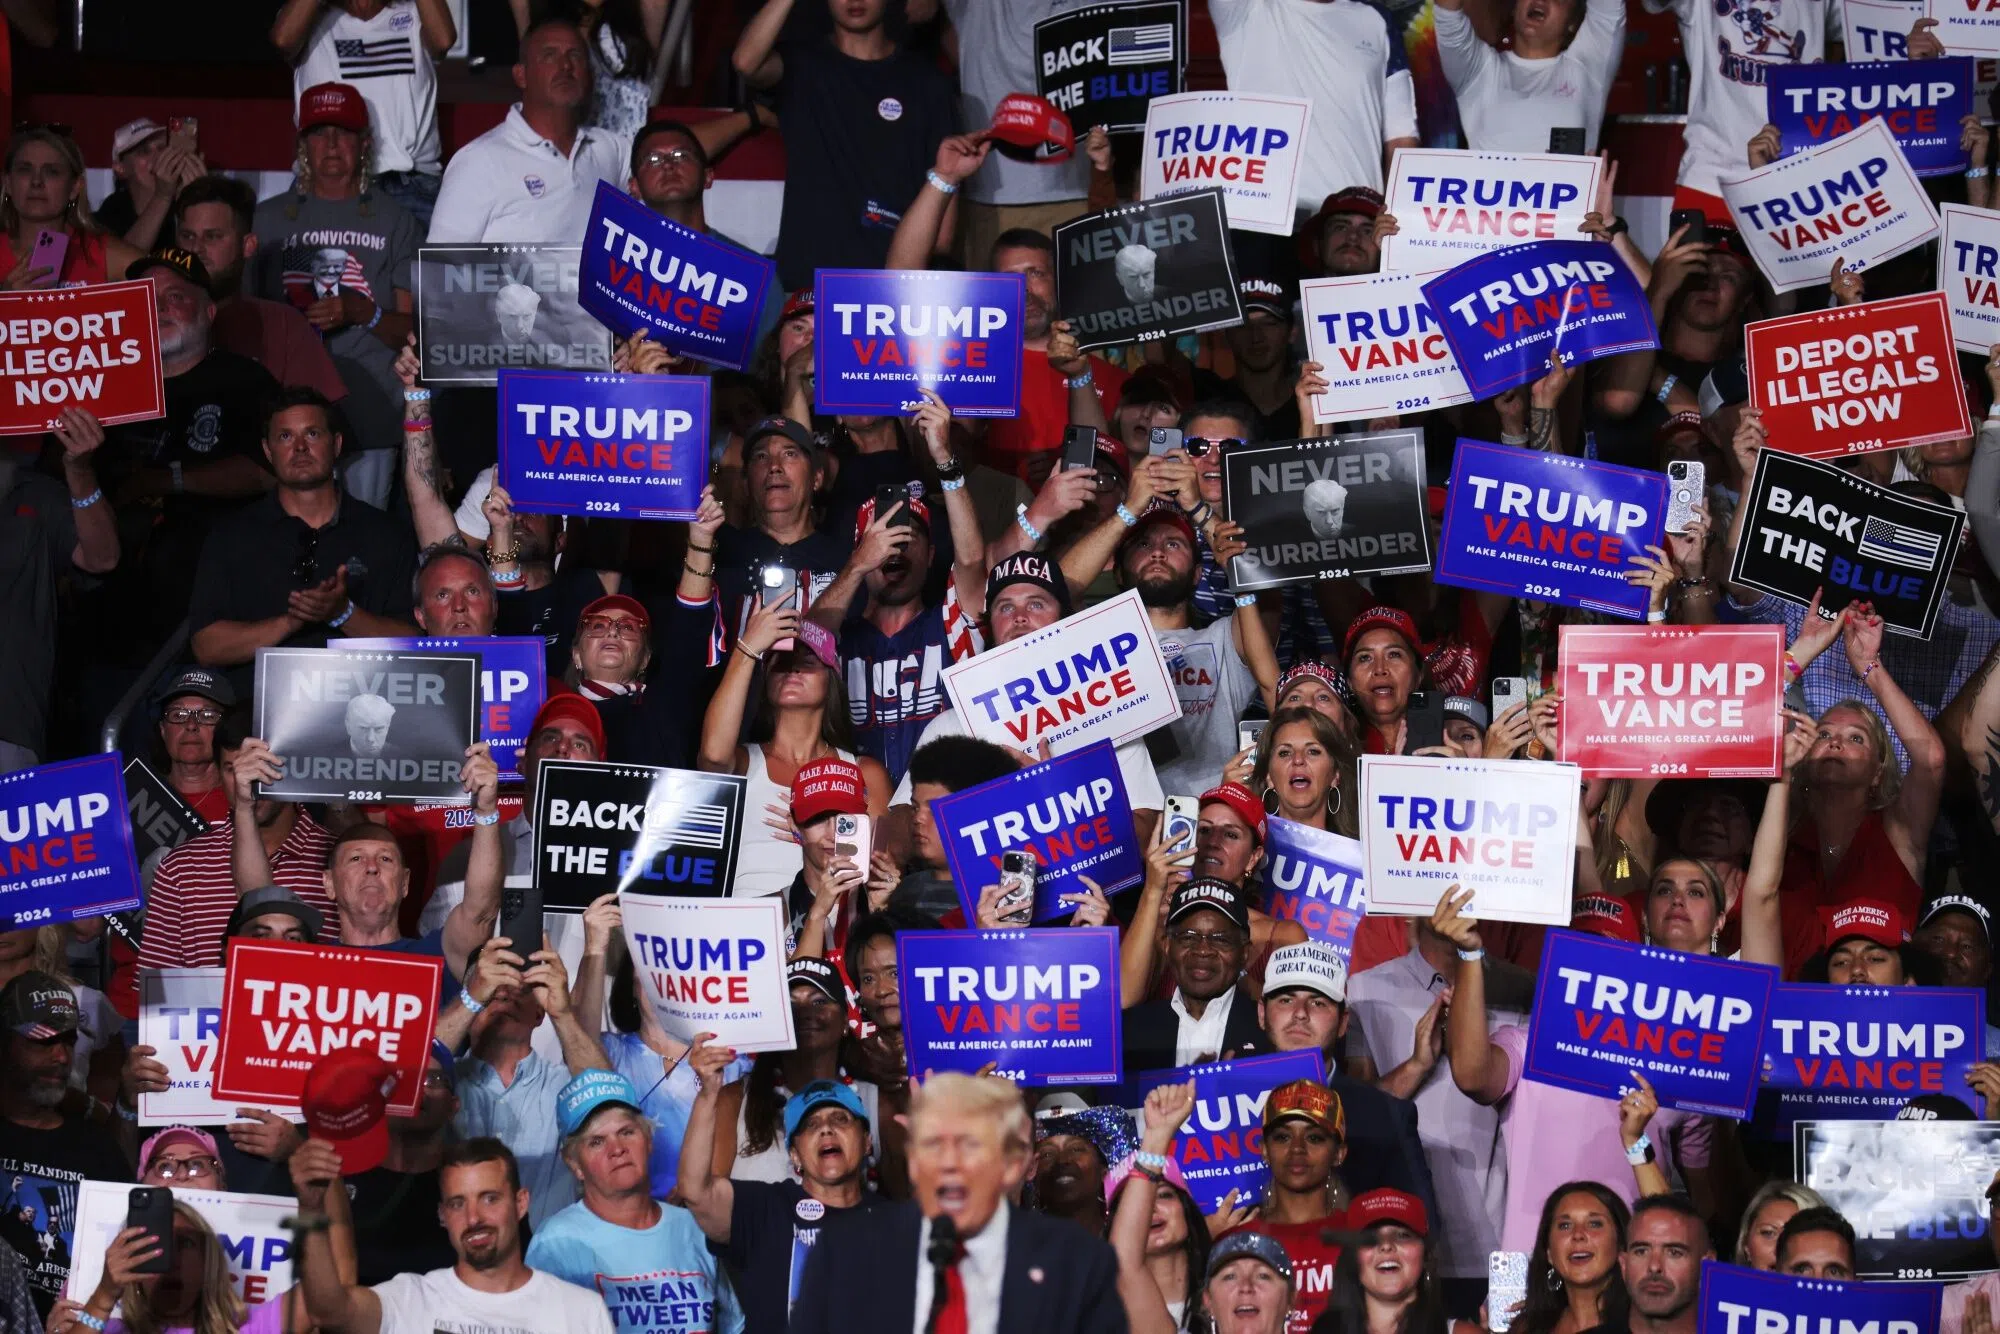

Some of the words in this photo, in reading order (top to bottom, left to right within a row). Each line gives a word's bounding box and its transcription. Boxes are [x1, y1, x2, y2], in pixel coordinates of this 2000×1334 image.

[1949, 17, 1977, 25] MAKE
[1043, 36, 1105, 77] BACK
[1046, 81, 1084, 111] THE
[1091, 71, 1169, 100] BLUE
[1784, 82, 1956, 113] TRUMP
[1154, 124, 1289, 158] TRUMP
[1910, 137, 1947, 147] AGAIN!
[1162, 155, 1266, 185] VANCE
[1236, 189, 1271, 199] AGAIN!
[1407, 176, 1578, 209] TRUMP
[1739, 156, 1889, 232] TRUMP
[1423, 207, 1557, 238] VANCE
[1769, 190, 1892, 251] VANCE
[303, 231, 386, 251] CONVICTIONS
[1070, 213, 1197, 266] NEVER
[1409, 239, 1438, 247] MAKE
[1442, 241, 1487, 250] AMERICA
[1777, 253, 1799, 265] MAKE
[1801, 245, 1839, 262] AMERICA
[1840, 232, 1872, 248] GREAT
[1874, 211, 1908, 236] AGAIN!
[602, 218, 748, 307] TRUMP
[609, 257, 723, 331] VANCE
[1450, 261, 1614, 328] TRUMP
[596, 281, 616, 299] MAKE
[617, 297, 652, 322] AMERICA
[655, 318, 686, 337] GREAT
[690, 330, 726, 344] AGAIN!
[833, 303, 1008, 339] TRUMP
[1066, 287, 1230, 337] SURRENDER
[1481, 284, 1612, 340] VANCE
[1955, 308, 1975, 319] MAKE
[1137, 330, 1166, 342] 2024
[1484, 345, 1513, 361] MAKE
[1515, 330, 1553, 348] AMERICA
[1555, 319, 1587, 336] GREAT
[1590, 312, 1626, 324] AGAIN!
[1775, 325, 1919, 373] DEPORT
[430, 344, 609, 366] SURRENDER
[852, 339, 987, 368] VANCE
[1340, 334, 1447, 372] VANC
[15, 373, 104, 406] NOW
[841, 372, 871, 381] MAKE
[873, 373, 919, 381] AMERICA
[960, 375, 996, 383] AGAIN!
[1334, 378, 1361, 388] MAKE
[1364, 374, 1410, 385] AMERICA
[1413, 368, 1446, 378] GREAT
[1766, 355, 1940, 407] ILLEGALS
[1396, 396, 1430, 410] 2024
[1811, 392, 1902, 431] NOW
[516, 404, 693, 440] TRUMP
[537, 440, 673, 470] VANCE
[1848, 438, 1883, 452] 2024
[525, 471, 555, 480] MAKE
[558, 473, 605, 483] AMERICA
[608, 475, 642, 485] GREAT
[645, 477, 682, 486] AGAIN!
[1250, 452, 1391, 496] NEVER
[586, 501, 621, 512] 2024
[1467, 475, 1648, 535] TRUMP
[1766, 485, 1862, 544] BACK
[1246, 532, 1418, 570] SURRENDER
[1483, 514, 1623, 564] VANCE
[995, 551, 1052, 583] MAGA
[1319, 568, 1350, 580] 2024
[1466, 545, 1497, 558] MAKE
[1499, 551, 1548, 567] AMERICA
[1551, 561, 1587, 573] GREAT
[1758, 526, 1827, 574] THE
[1829, 555, 1925, 601] BLUE
[1525, 583, 1561, 599] 2024
[291, 671, 445, 705] NEVER
[971, 631, 1138, 722] TRUMP
[1578, 663, 1765, 696] TRUMP
[1003, 669, 1136, 743] VANCE
[1083, 710, 1113, 730] GREAT
[1116, 694, 1149, 714] AGAIN!
[1598, 699, 1743, 728] VANCE
[486, 739, 521, 747] AGAIN!
[1586, 735, 1617, 743] MAKE
[1620, 735, 1670, 744] AMERICA
[1675, 735, 1710, 743] GREAT
[1714, 734, 1754, 743] AGAIN!
[276, 756, 462, 783] SURRENDER
[800, 765, 820, 782] MAKE
[823, 763, 858, 780] AMERICA
[1650, 763, 1687, 774] 2024
[349, 791, 382, 801] 2024
[804, 783, 827, 797] GREAT
[831, 780, 855, 795] AGAIN
[445, 810, 475, 828] 202
[549, 799, 644, 831] BACK
[959, 777, 1114, 856] TRUMP
[1378, 795, 1557, 837] TRUMP
[546, 846, 607, 875] THE
[1071, 855, 1098, 877] GREAT
[1100, 846, 1123, 862] AGAIN!
[1396, 833, 1534, 868] VANCE
[31, 874, 67, 887] GREAT
[71, 867, 110, 881] AGAIN!
[1387, 869, 1412, 877] MAKE
[1416, 871, 1458, 879] AMERICA
[1180, 885, 1235, 903] TRUMP
[1931, 895, 1990, 919] TRUMP
[14, 907, 51, 923] 2024
[104, 914, 129, 937] 2024
[1833, 907, 1851, 922] MAKE
[1851, 906, 1889, 920] AMERICA
[1835, 915, 1857, 928] GREAT
[1860, 915, 1886, 926] AGAIN
[635, 933, 765, 971] TRUMP
[1274, 949, 1299, 962] MAKE
[1299, 947, 1342, 968] AMERICA
[915, 964, 1100, 1001] TRUMP
[1275, 962, 1304, 975] GREAT
[1307, 963, 1336, 980] AGAIN
[651, 973, 750, 1004] VANCE
[1557, 967, 1753, 1033] TRUMP
[244, 980, 422, 1029] TRUMP
[692, 1012, 721, 1020] GREAT
[724, 1012, 762, 1020] AGAIN!
[936, 1004, 1080, 1033] VANCE
[929, 1040, 956, 1049] MAKE
[959, 1039, 1007, 1050] AMERICA
[1011, 1039, 1047, 1049] GREAT
[1051, 1038, 1092, 1048] AGAIN!
[1574, 1009, 1726, 1063] VANCE
[1772, 1019, 1965, 1058] TRUMP
[245, 1056, 277, 1068] MAKE
[1556, 1041, 1589, 1056] MAKE
[1592, 1049, 1644, 1068] AMERICA
[1648, 1060, 1685, 1074] GREAT
[1689, 1067, 1730, 1081] AGAIN!
[1794, 1057, 1944, 1090] VANCE
[1782, 1094, 1814, 1102] MAKE
[1817, 1095, 1869, 1104] AMERICA
[1872, 1096, 1909, 1105] GREAT
[1898, 1269, 1932, 1278] 2024
[617, 1281, 698, 1304] MEAN
[610, 1301, 714, 1327] TWEETS
